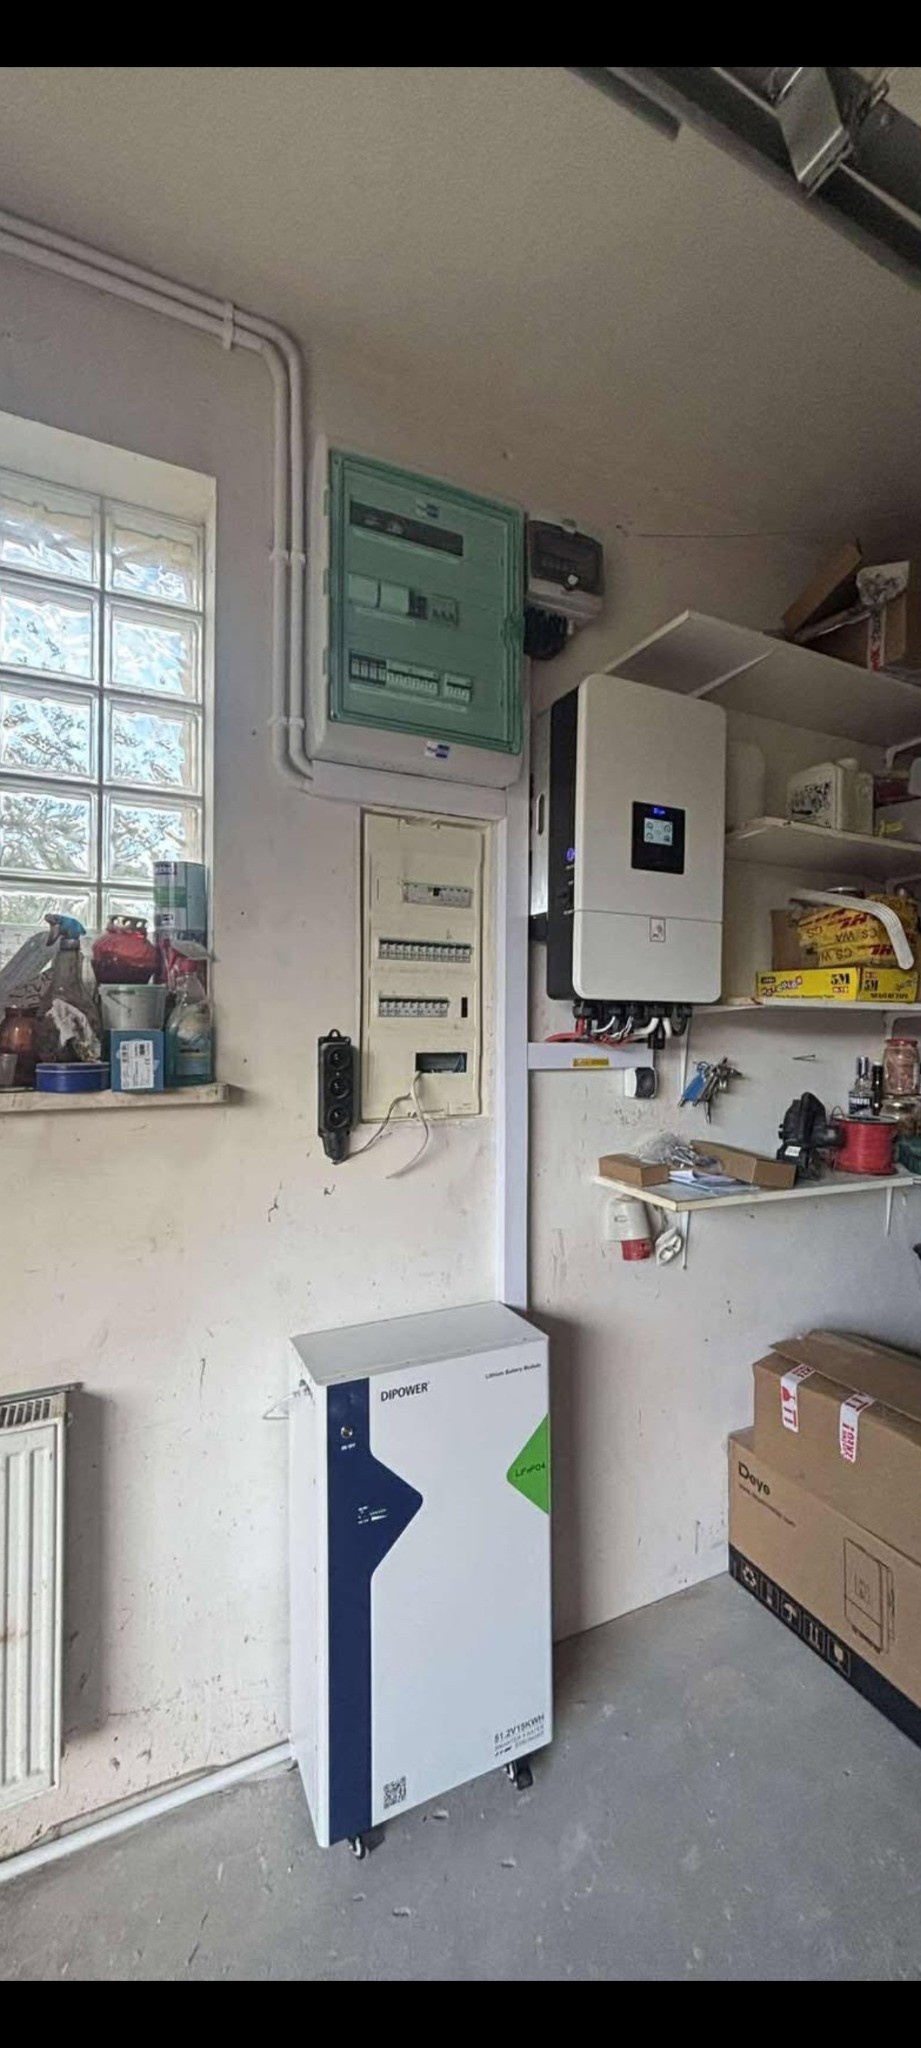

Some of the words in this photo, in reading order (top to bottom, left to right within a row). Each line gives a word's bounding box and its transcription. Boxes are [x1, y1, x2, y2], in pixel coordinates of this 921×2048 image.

[831, 973, 850, 985] 5M
[380, 1382, 428, 1402] DIPOWER
[738, 1460, 771, 1496] Deye
